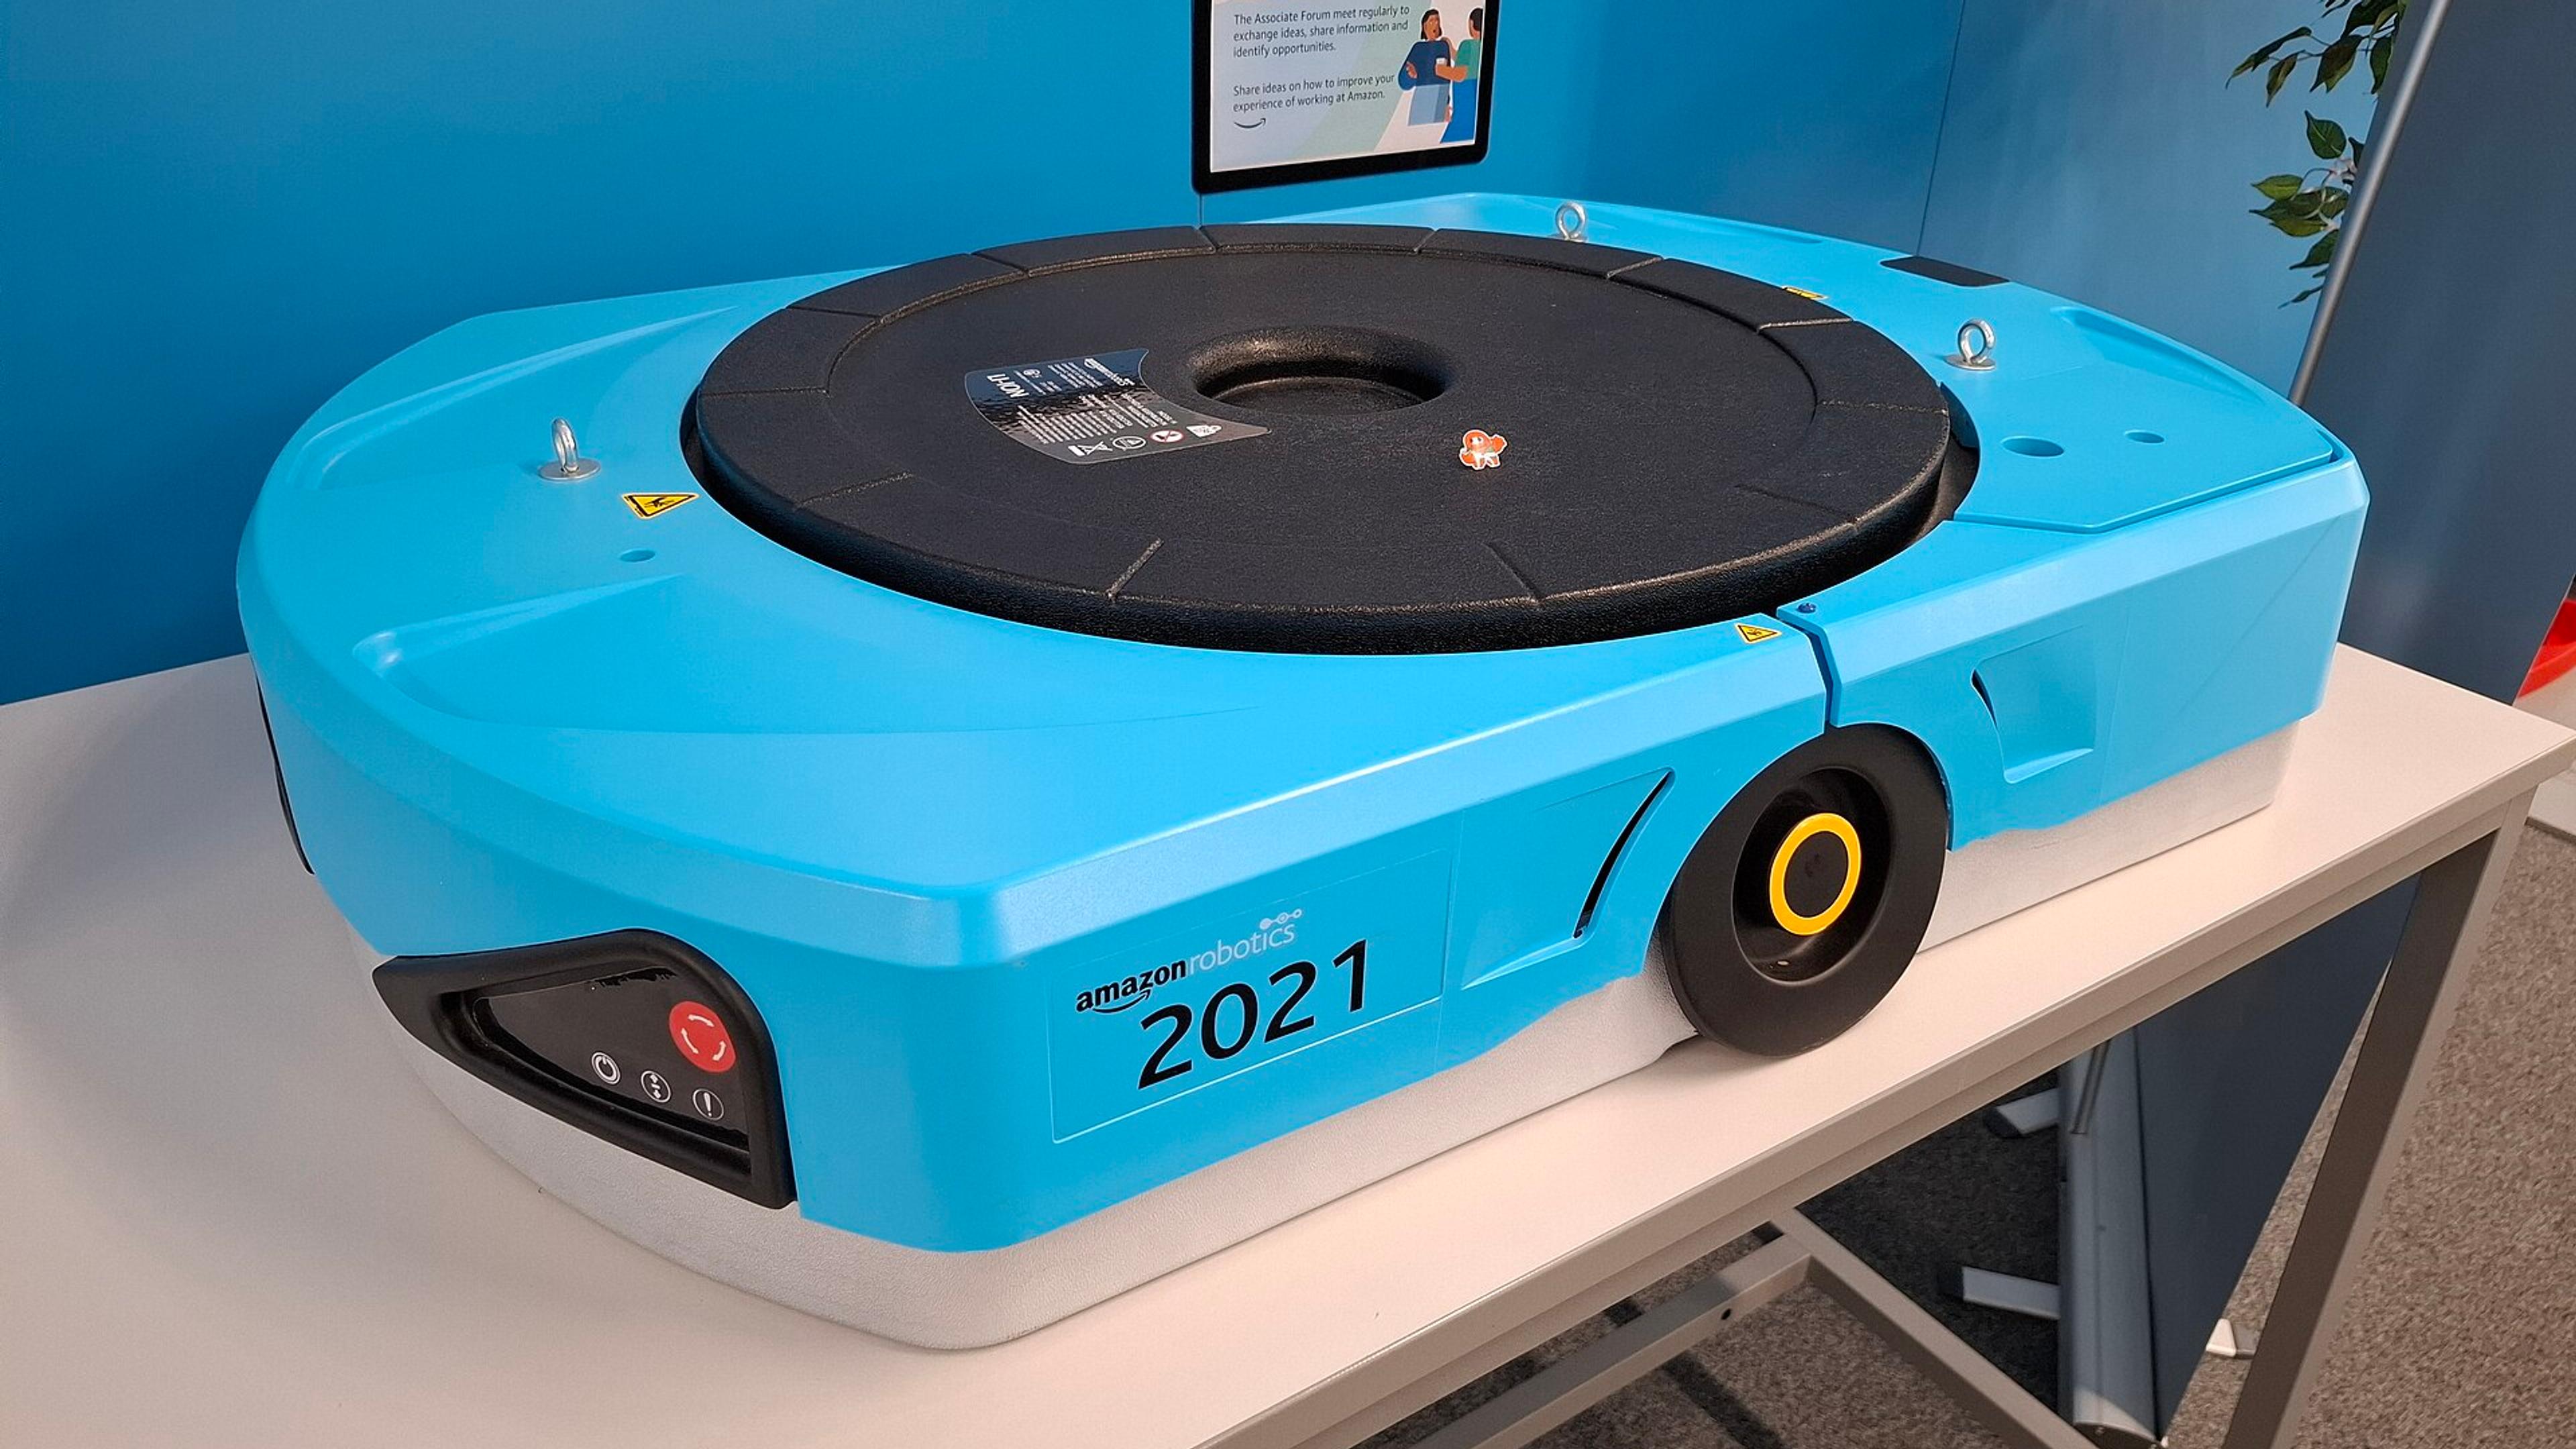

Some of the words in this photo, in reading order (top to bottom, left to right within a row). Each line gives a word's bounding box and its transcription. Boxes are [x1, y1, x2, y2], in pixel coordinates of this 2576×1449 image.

[1234, 13, 1252, 25] The
[1254, 12, 1298, 23] Associate
[1301, 10, 1331, 21] Forum
[1333, 9, 1356, 19] meet
[1358, 5, 1398, 19] regularly
[1400, 5, 1409, 15] to
[1234, 30, 1278, 42] exchange
[1281, 27, 1307, 38] ideas,
[1309, 25, 1334, 36] share
[1336, 21, 1389, 35] information
[1391, 19, 1408, 30] and
[1234, 44, 1270, 58] identify
[1272, 40, 1336, 57] opportunities.
[1234, 85, 1260, 96] Share
[1263, 82, 1286, 94] ideas
[1289, 83, 1301, 91] on
[1303, 79, 1322, 91] how
[1326, 79, 1334, 88] to
[1337, 76, 1373, 89] improve
[1375, 75, 1395, 86] your
[1233, 99, 1283, 113] experience
[1285, 95, 1295, 107] of
[1297, 93, 1334, 105] working
[1336, 94, 1345, 103] at
[1347, 91, 1385, 102] Amazon.
[1137, 939, 1367, 1090] 2021
